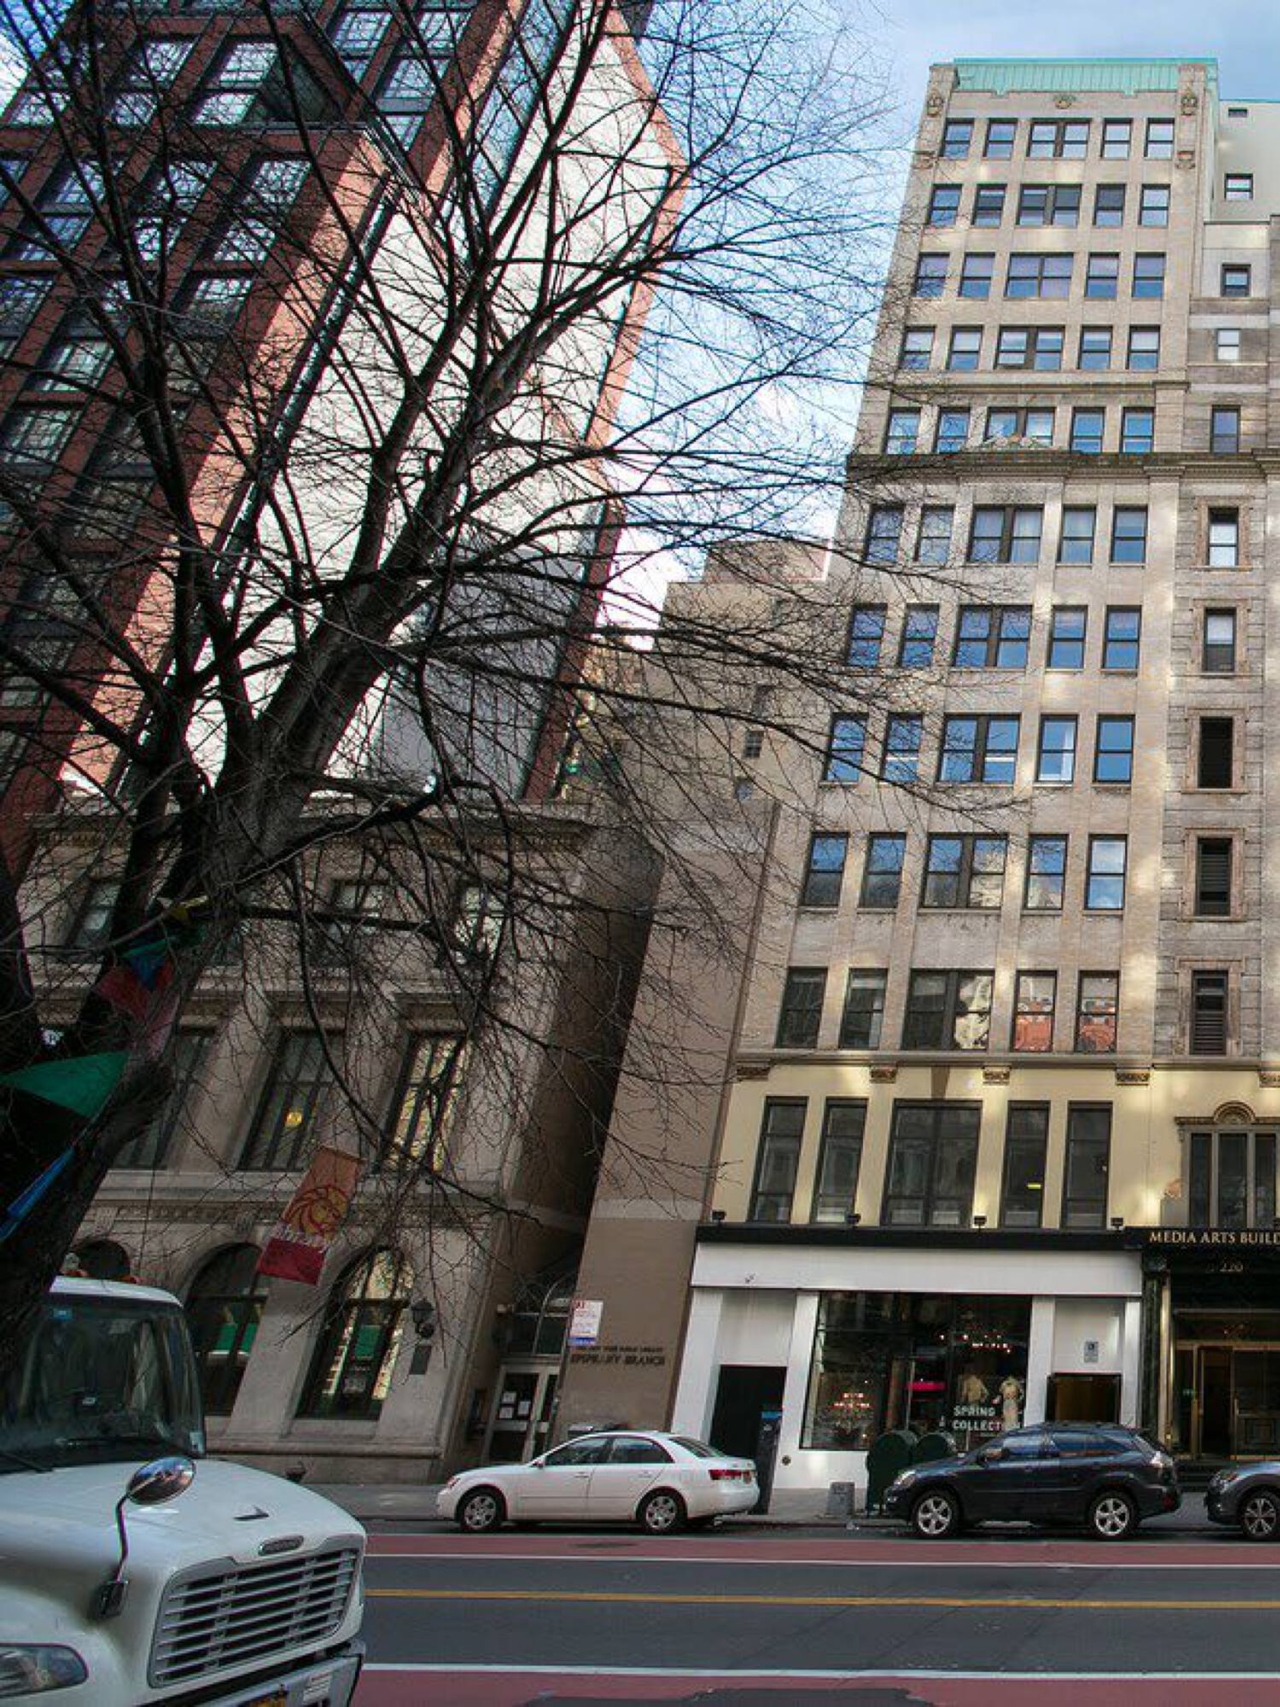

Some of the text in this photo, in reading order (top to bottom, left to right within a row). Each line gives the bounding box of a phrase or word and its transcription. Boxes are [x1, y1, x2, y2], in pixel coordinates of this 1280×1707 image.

[1149, 1231, 1197, 1244] MEDIA
[1201, 1232, 1236, 1244] ARTS
[953, 1405, 996, 1416] SPRING
